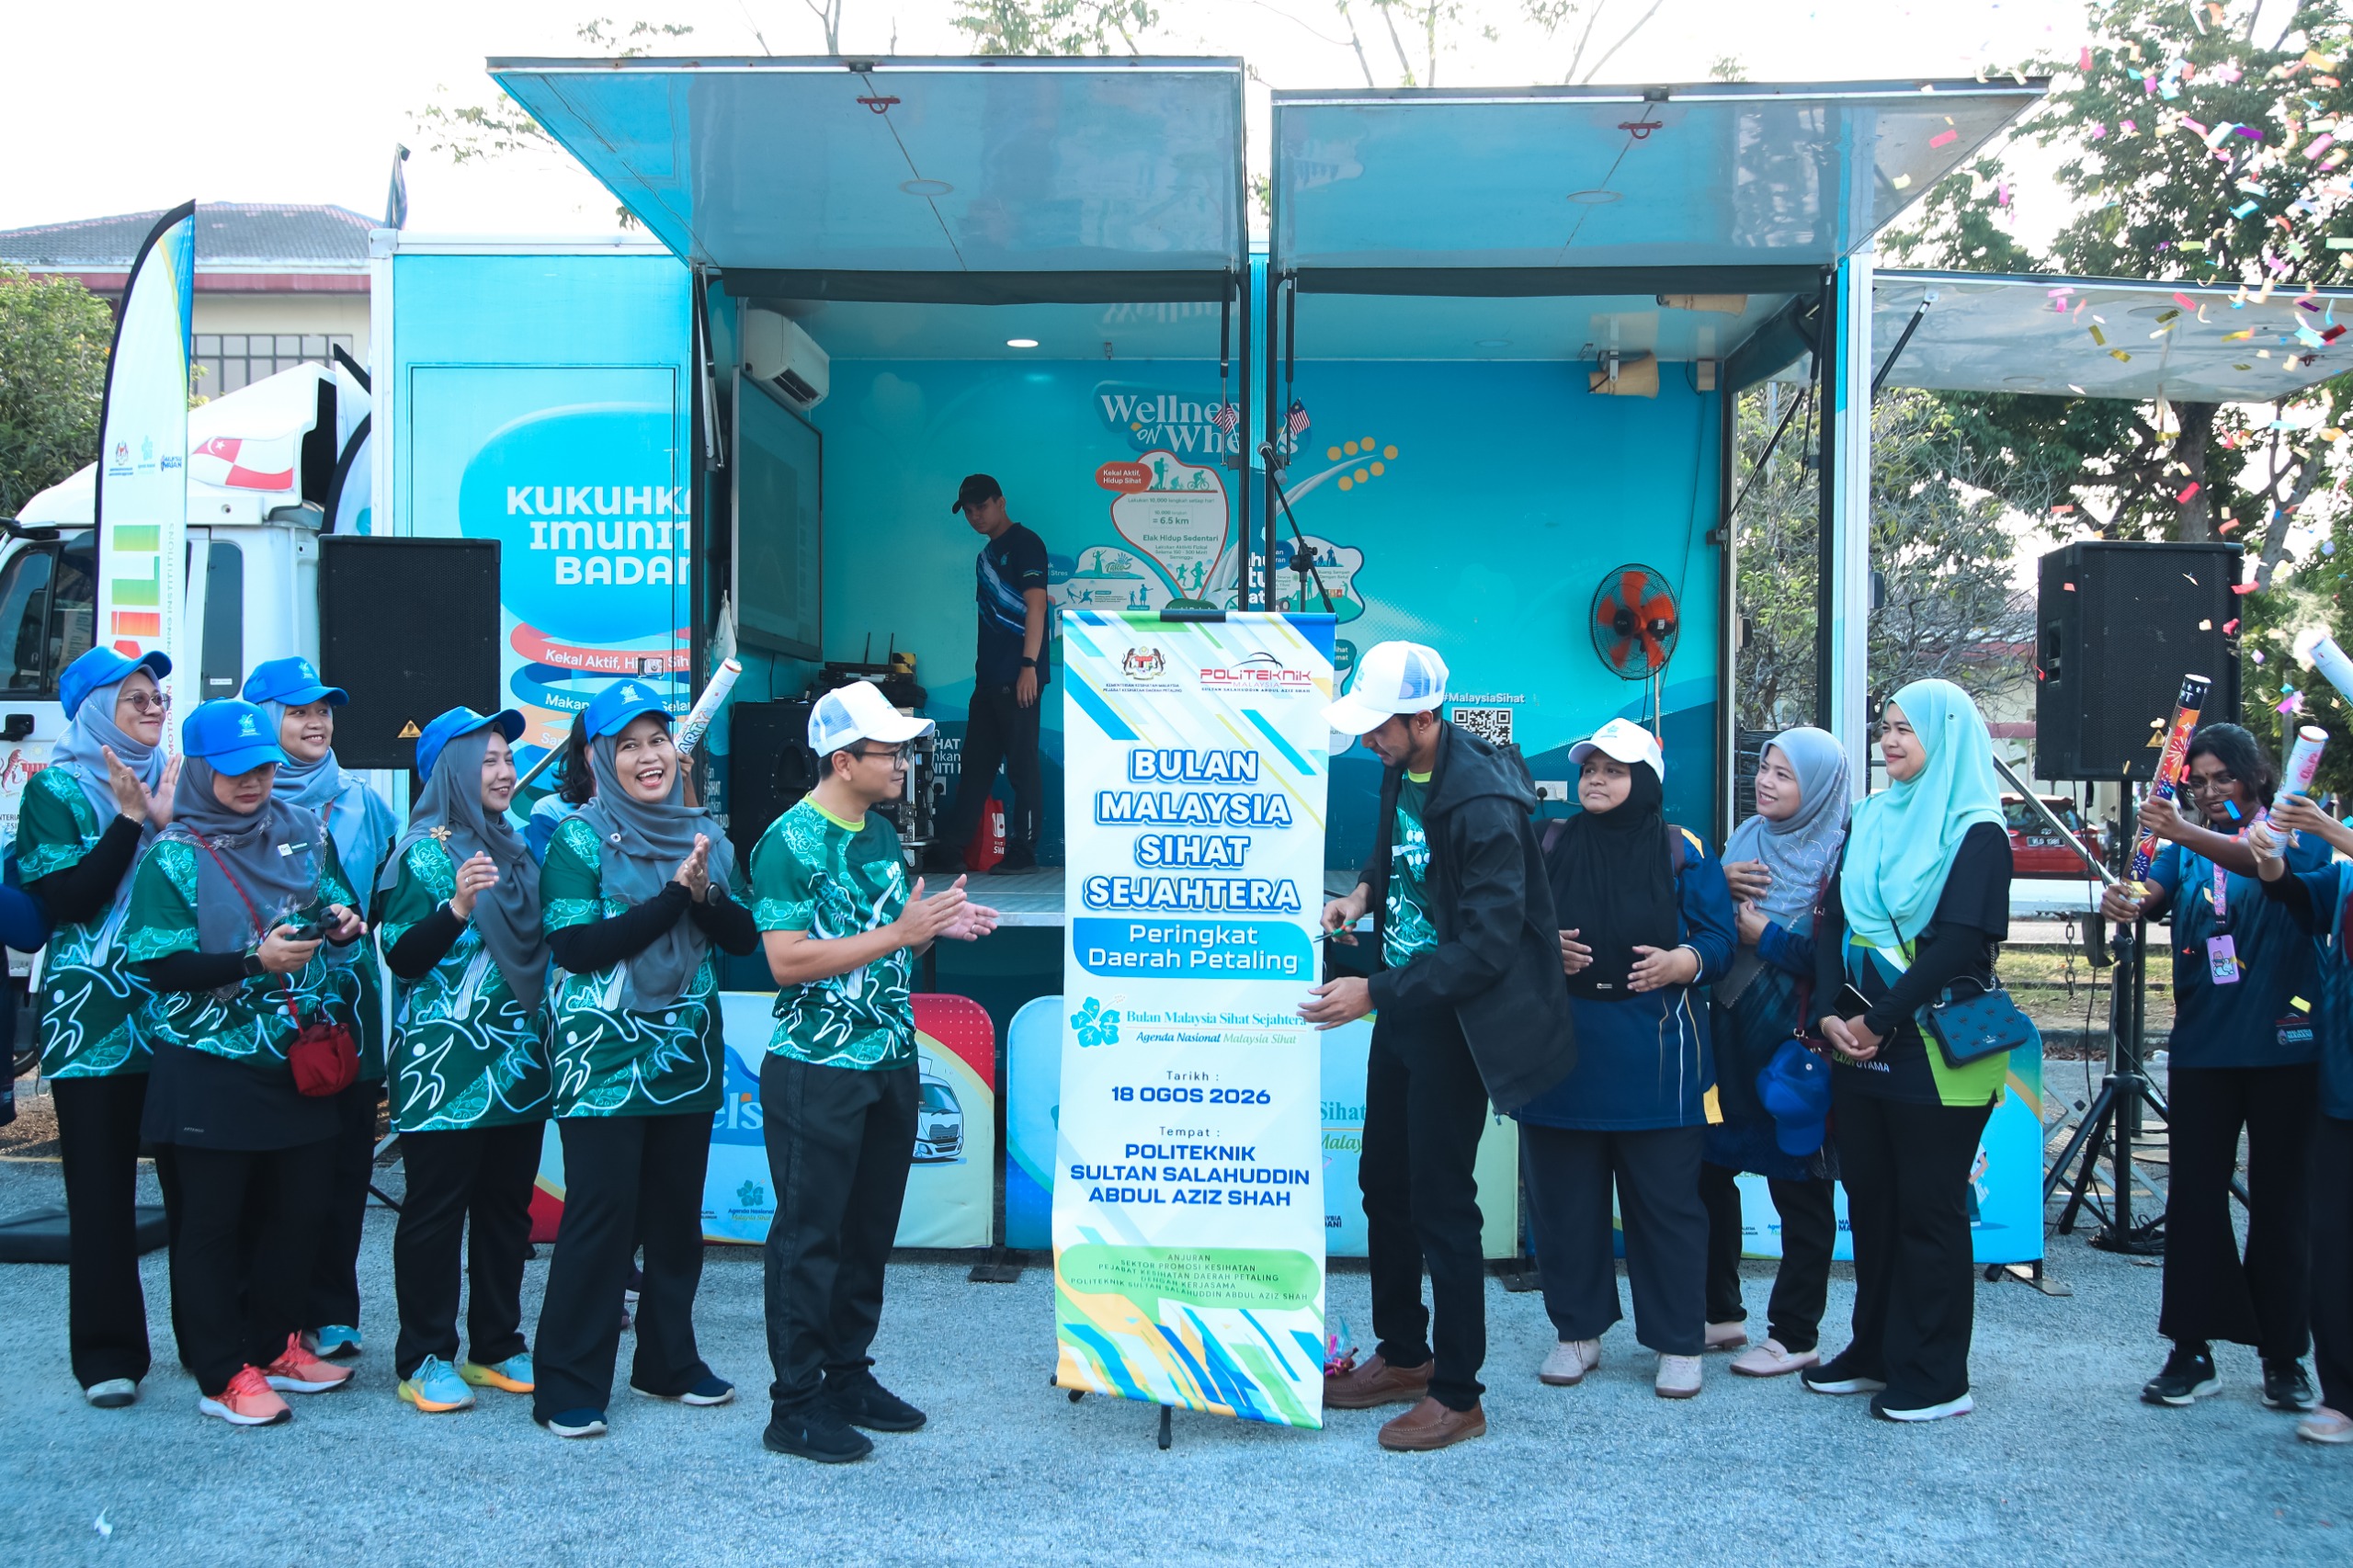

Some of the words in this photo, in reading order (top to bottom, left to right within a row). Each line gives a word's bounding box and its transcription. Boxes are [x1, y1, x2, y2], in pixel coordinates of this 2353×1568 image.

[1160, 517, 1174, 525] 6.5
[1176, 517, 1189, 525] km
[545, 649, 583, 666] Kekal
[585, 654, 621, 671] Aktif,
[667, 656, 690, 668] Sih
[1131, 749, 1258, 780] BULAN
[1100, 791, 1292, 824] MALAYSIA
[1138, 835, 1251, 866] SIHAT
[1087, 876, 1301, 909] SEJAHTERA
[1130, 924, 1258, 949] Peringkat
[1088, 948, 1181, 968] Daerah
[1189, 949, 1298, 974] Petaling
[1127, 1010, 1161, 1023] Bulan
[1165, 1011, 1217, 1027] Malaysia
[1220, 1013, 1249, 1025] Sihat
[1252, 1014, 1306, 1028] Sejahtera
[1136, 1031, 1174, 1043] Agenda
[1176, 1032, 1221, 1042] Nasional
[1222, 1033, 1268, 1045] Malaysia
[1271, 1034, 1296, 1044] Sihat
[1166, 1070, 1209, 1081] Tarikh
[1111, 1086, 1133, 1101] 18
[1140, 1086, 1203, 1103] OGOS
[1209, 1088, 1271, 1104] 2026
[1159, 1127, 1211, 1139] Tempat
[1125, 1143, 1256, 1162] POLITEKNIK
[1071, 1165, 1156, 1181] SULTAN
[1163, 1166, 1310, 1185] SALAHUDDIN
[1088, 1187, 1166, 1204] ABDUL
[1172, 1189, 1222, 1205] AZIZ
[1228, 1189, 1290, 1206] SHAH
[1120, 1259, 1155, 1269] SEKTOR
[1158, 1262, 1201, 1271] PROMOSI
[1204, 1263, 1256, 1272] KESIHATAN
[1167, 1254, 1211, 1262] ANJURAN
[1098, 1263, 1137, 1275] PEJABAT
[1193, 1272, 1231, 1280] DAERAH
[1234, 1273, 1279, 1282] PETALING
[1071, 1278, 1125, 1286] POLITEKNIK
[1165, 1286, 1222, 1299] SALAHUDDIN
[1225, 1291, 1256, 1300] ABDUL
[1258, 1292, 1279, 1301] AZIZ
[1181, 1280, 1235, 1289] KERJASAMA
